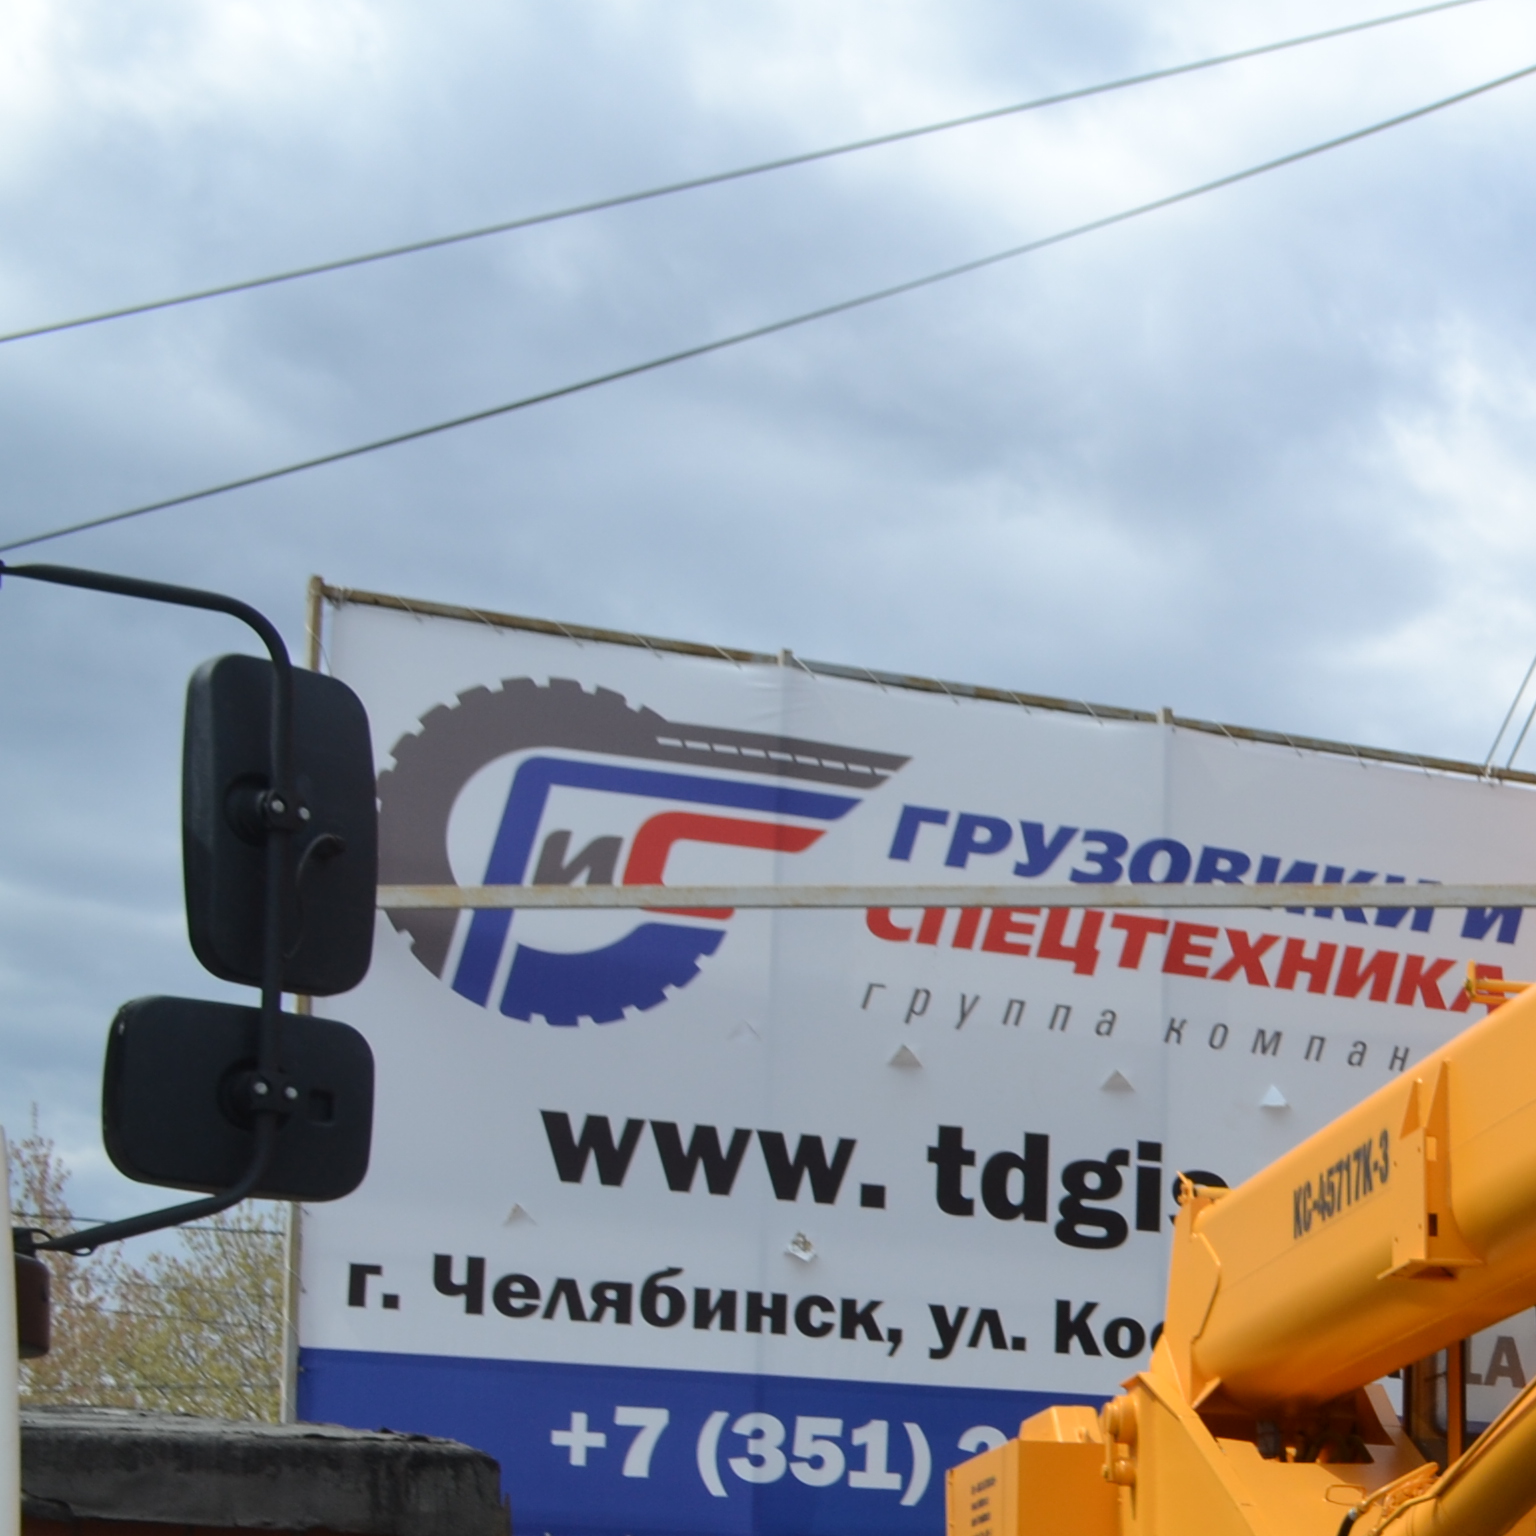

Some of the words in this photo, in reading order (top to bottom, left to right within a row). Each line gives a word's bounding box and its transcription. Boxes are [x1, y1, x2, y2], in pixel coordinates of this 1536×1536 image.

[888, 804, 1443, 933] ГРУЗОВИКИ
[862, 983, 1118, 1036] группа
[540, 1109, 886, 1209] www.
[348, 1262, 400, 1310] г.
[433, 1253, 903, 1357] Челябинск,
[928, 1303, 1026, 1359] ул.
[551, 1406, 669, 1477] +7
[697, 1411, 931, 1506] (351)
